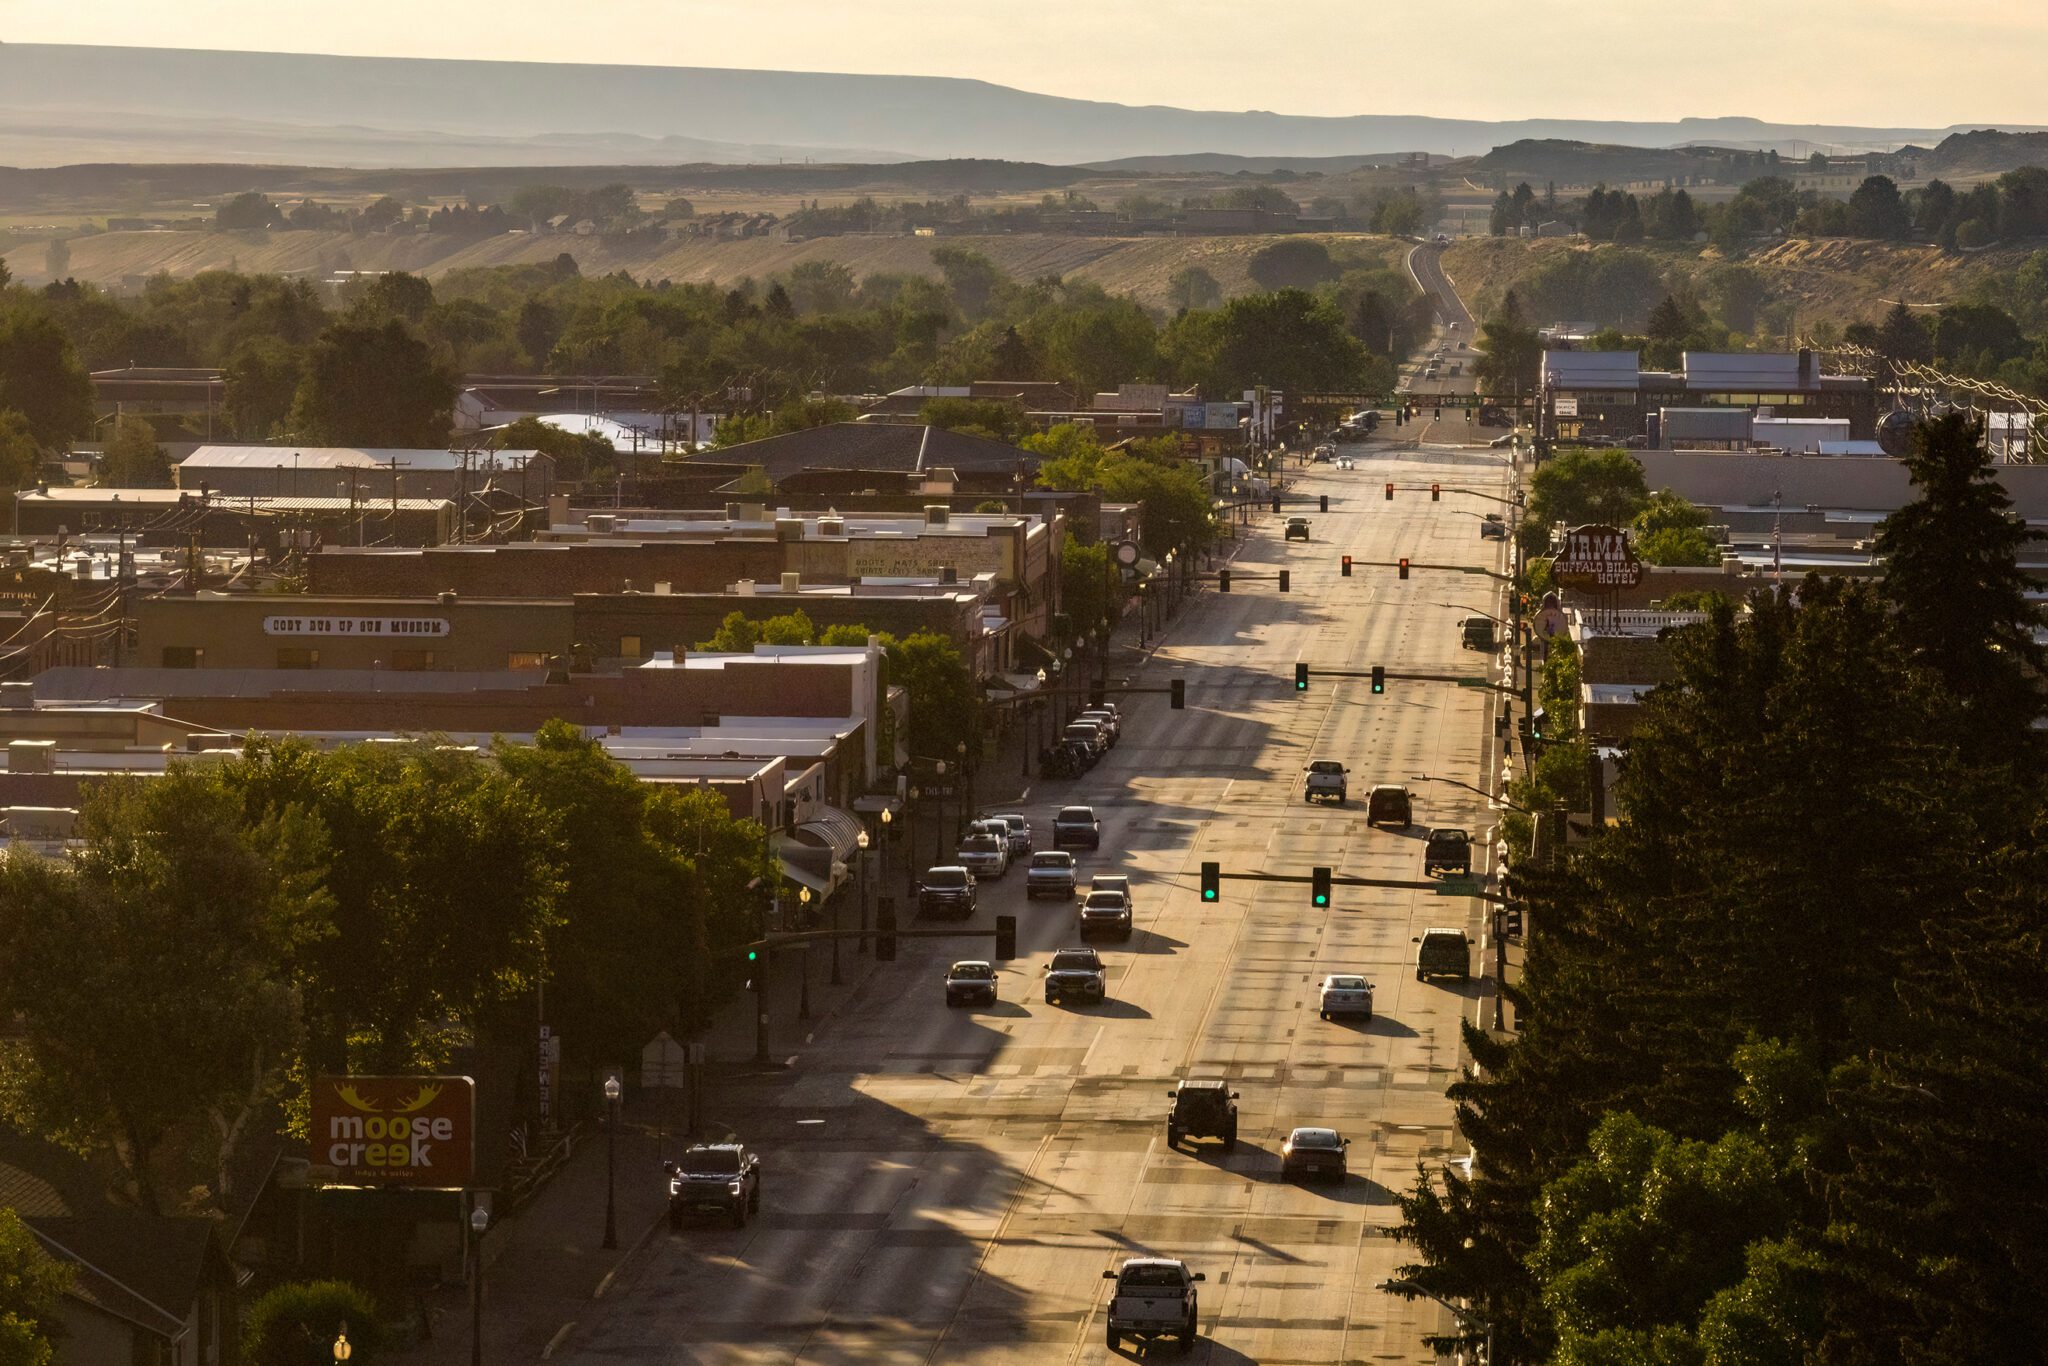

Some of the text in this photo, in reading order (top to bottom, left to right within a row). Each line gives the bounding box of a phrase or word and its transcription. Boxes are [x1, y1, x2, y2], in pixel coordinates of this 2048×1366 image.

[1569, 535, 1625, 561] IRMA
[895, 559, 918, 567] HATS
[1555, 561, 1639, 573] BUFFALO BILLS
[1598, 573, 1636, 584] HOTEL
[273, 619, 441, 633] CODY DUG UP GUN MUSEUM
[330, 1115, 453, 1141] moose
[328, 1132, 433, 1167] creek
